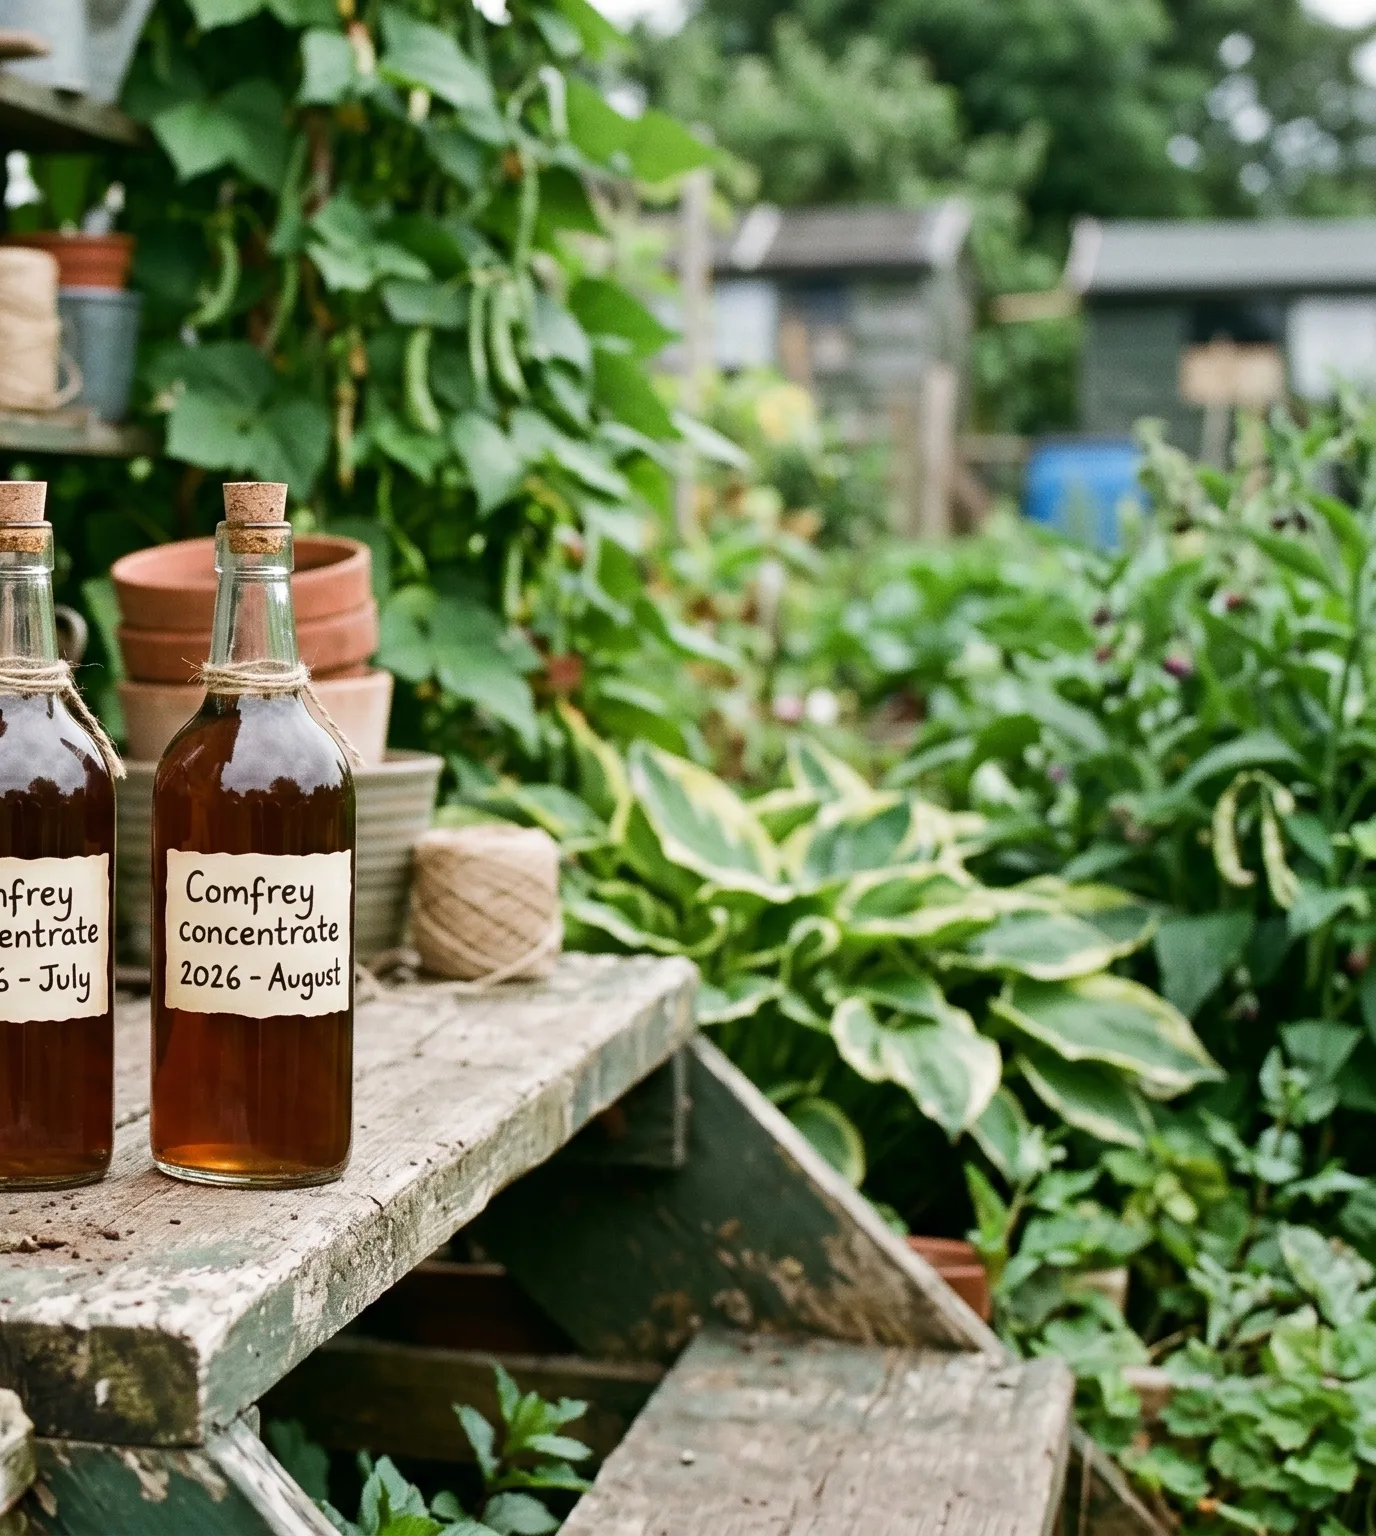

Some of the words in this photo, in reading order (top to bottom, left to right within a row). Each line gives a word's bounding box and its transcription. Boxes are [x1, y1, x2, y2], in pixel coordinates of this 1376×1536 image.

[185, 869, 314, 921] Comfrey
[38, 962, 91, 1004] July
[180, 960, 241, 991] 2026
[267, 957, 341, 1001] August
